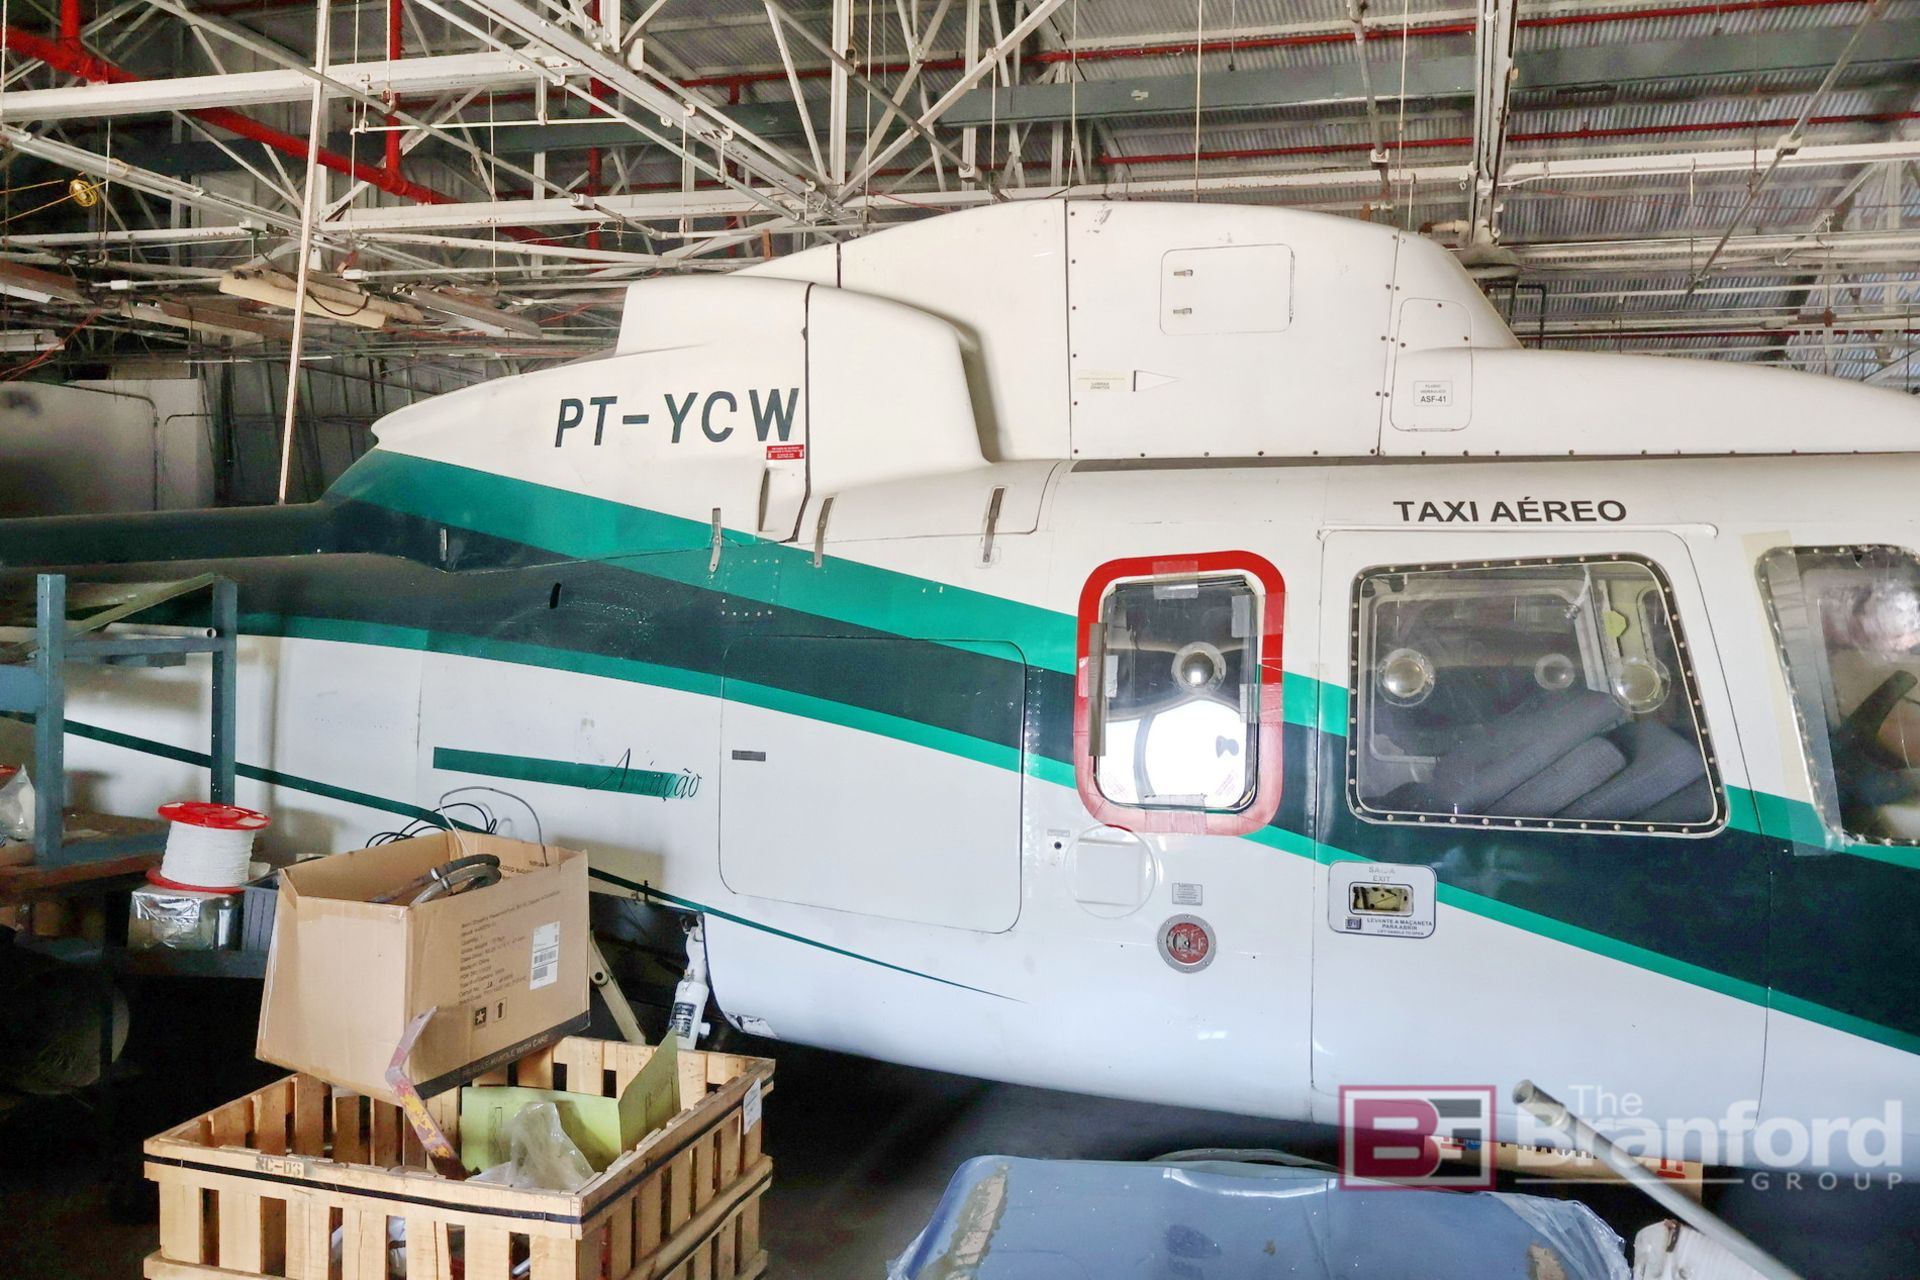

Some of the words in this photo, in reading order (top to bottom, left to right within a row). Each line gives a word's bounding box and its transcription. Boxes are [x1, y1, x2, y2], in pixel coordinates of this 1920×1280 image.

[1420, 395, 1447, 403] ASF-41
[554, 387, 800, 448] PT-YCW
[1393, 500, 1479, 523] TAXI
[1490, 496, 1627, 523] AÉREO
[1400, 919, 1433, 927] MAÇANETA
